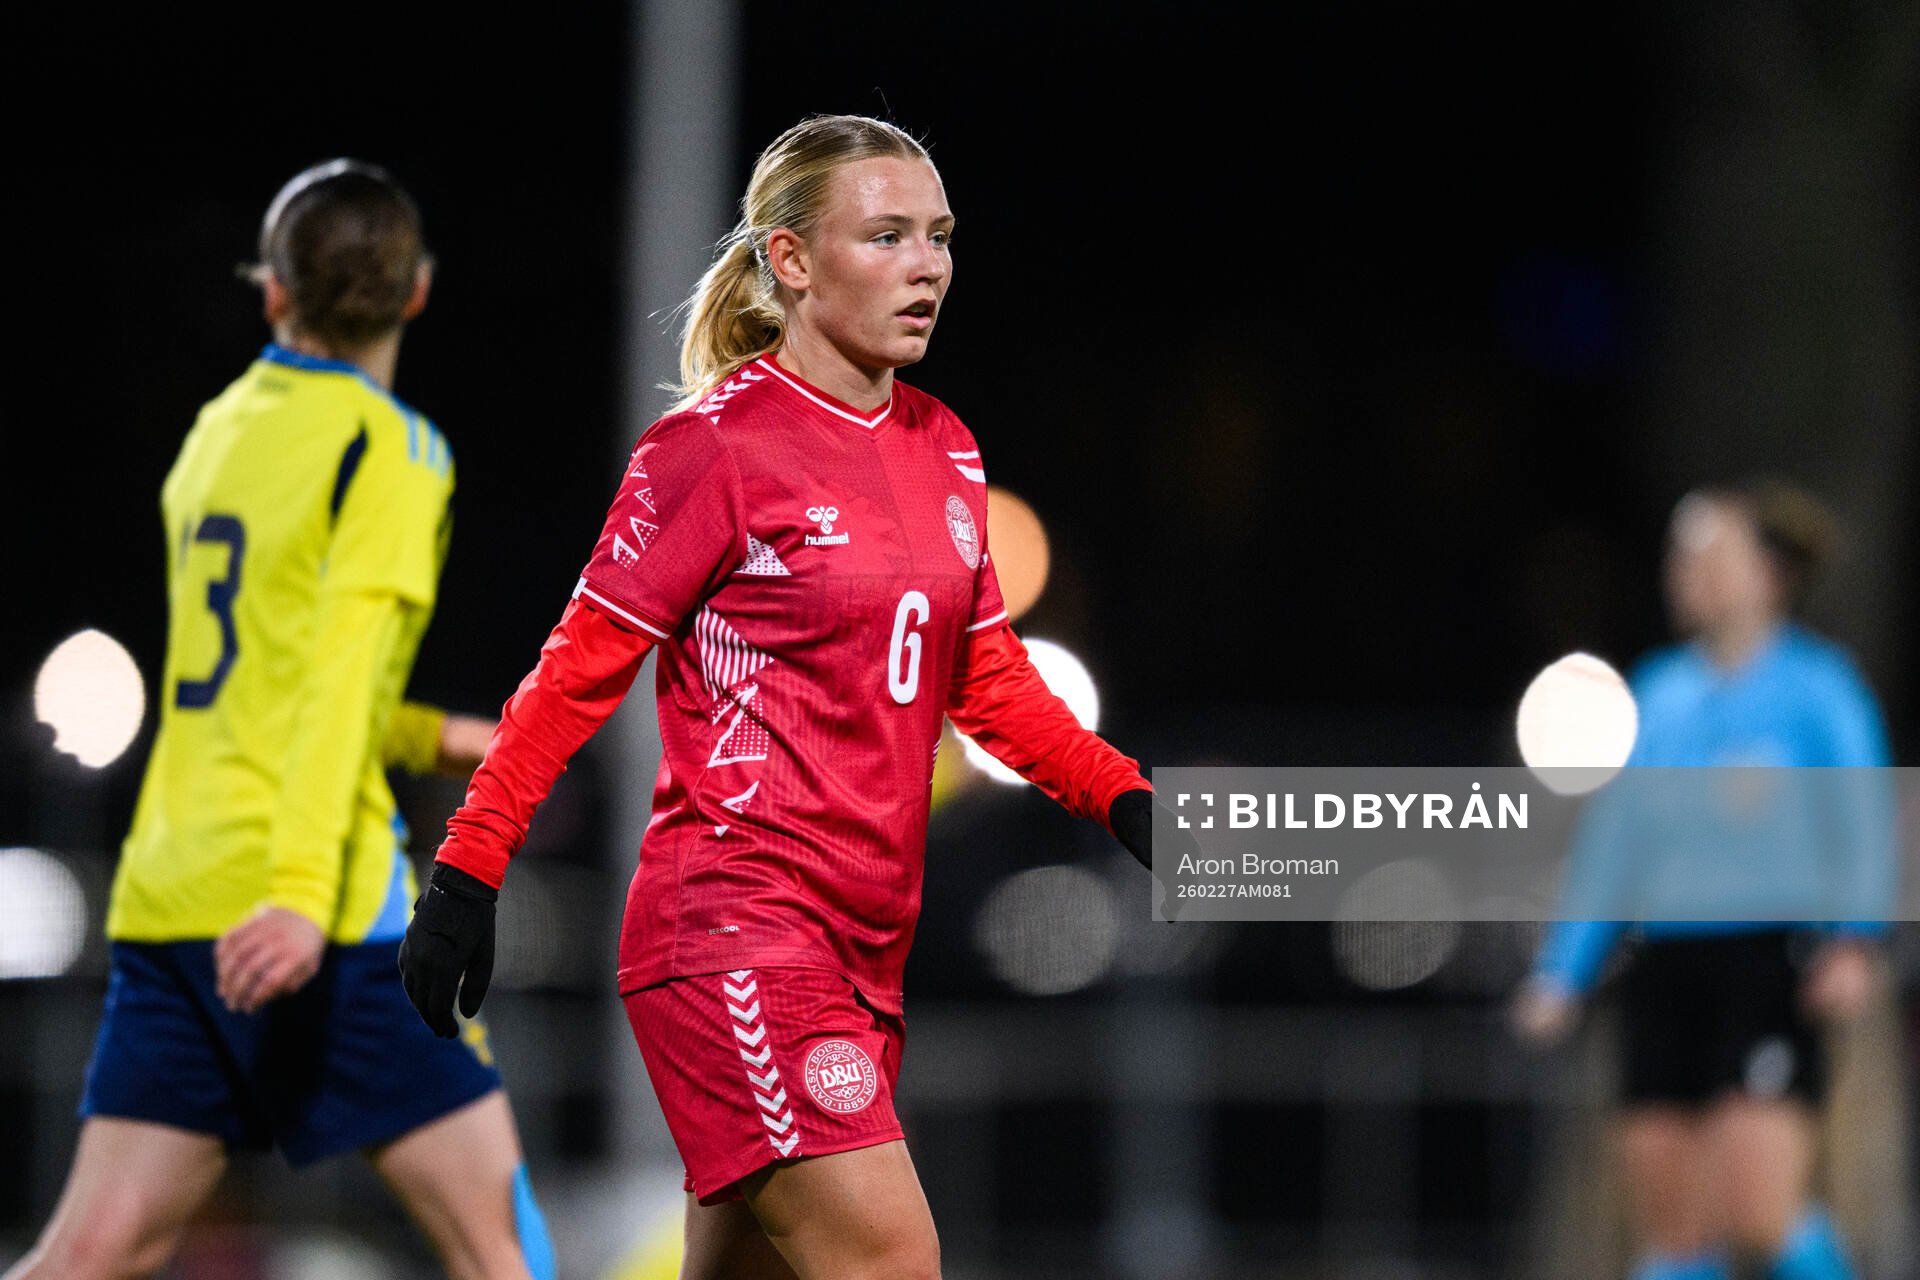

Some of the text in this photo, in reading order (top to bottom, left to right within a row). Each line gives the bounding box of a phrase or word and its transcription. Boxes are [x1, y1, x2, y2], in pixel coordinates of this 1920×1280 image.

[805, 532, 849, 546] hummel
[888, 591, 930, 704] 6
[819, 1062, 862, 1089] DBU
[860, 1057, 874, 1096] UNION
[838, 1097, 865, 1110] 1889
